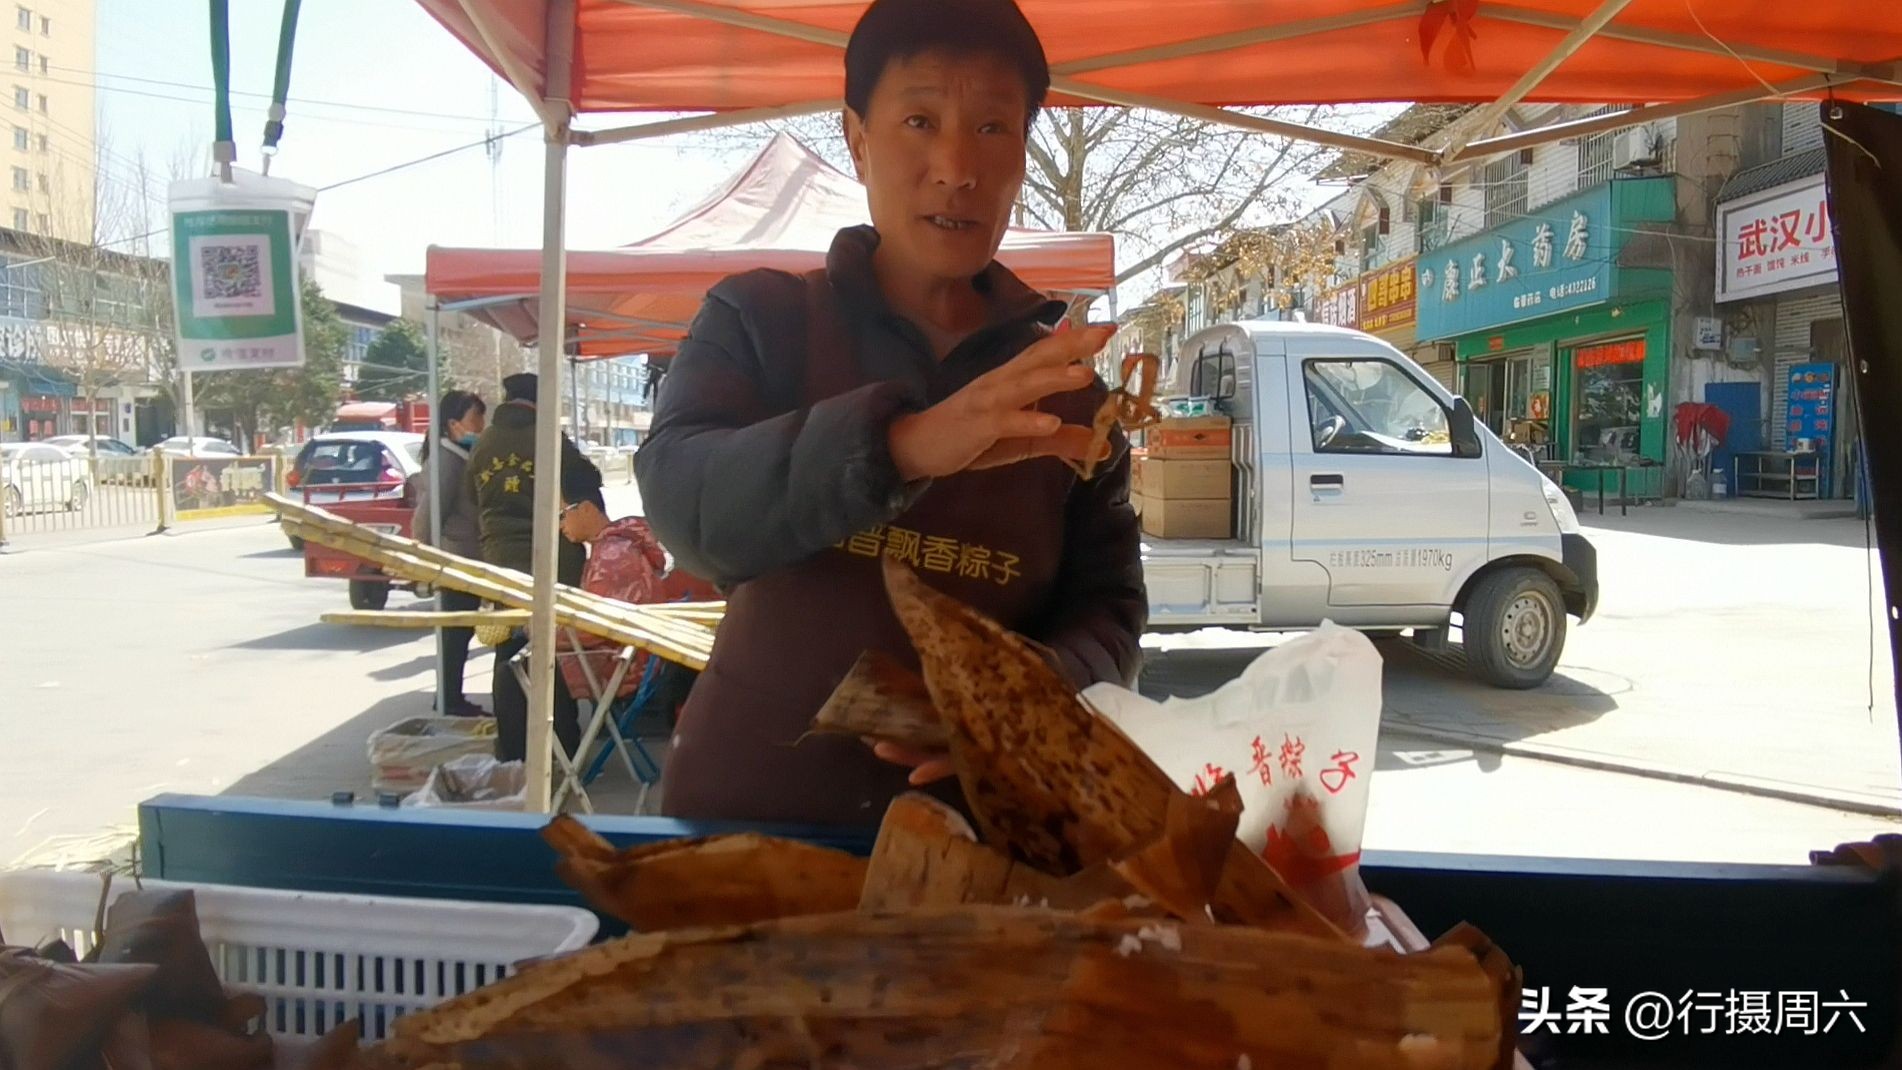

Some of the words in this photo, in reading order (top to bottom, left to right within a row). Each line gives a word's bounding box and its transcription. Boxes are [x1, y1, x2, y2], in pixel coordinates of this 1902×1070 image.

[1441, 209, 1590, 303] 康正大药房
[833, 522, 1022, 586] 晋飘香粽子
